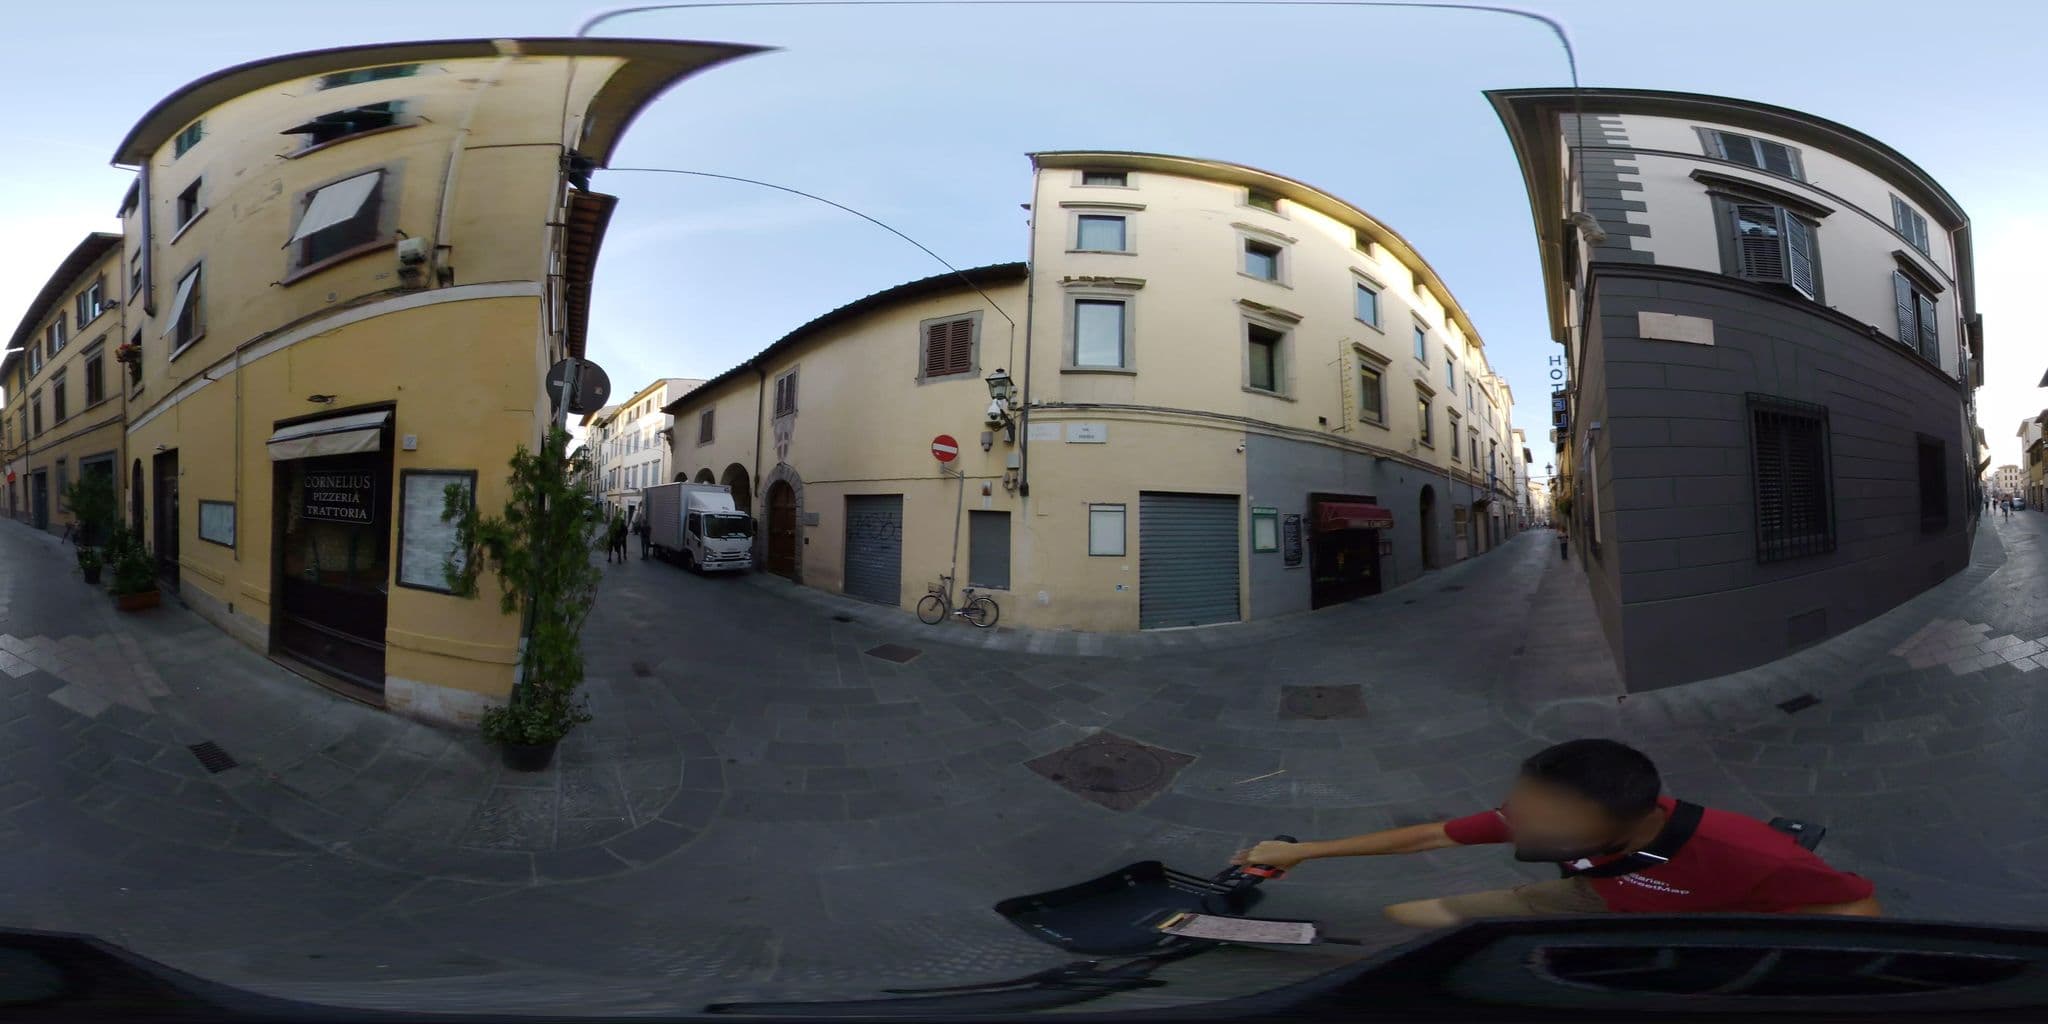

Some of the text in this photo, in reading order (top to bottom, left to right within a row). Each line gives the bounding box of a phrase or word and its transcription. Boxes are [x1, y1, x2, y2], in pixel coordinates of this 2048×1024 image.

[304, 474, 371, 489] CORNELIUS
[313, 491, 360, 503] PIZZERIA
[306, 504, 367, 519] TRATTORIA
